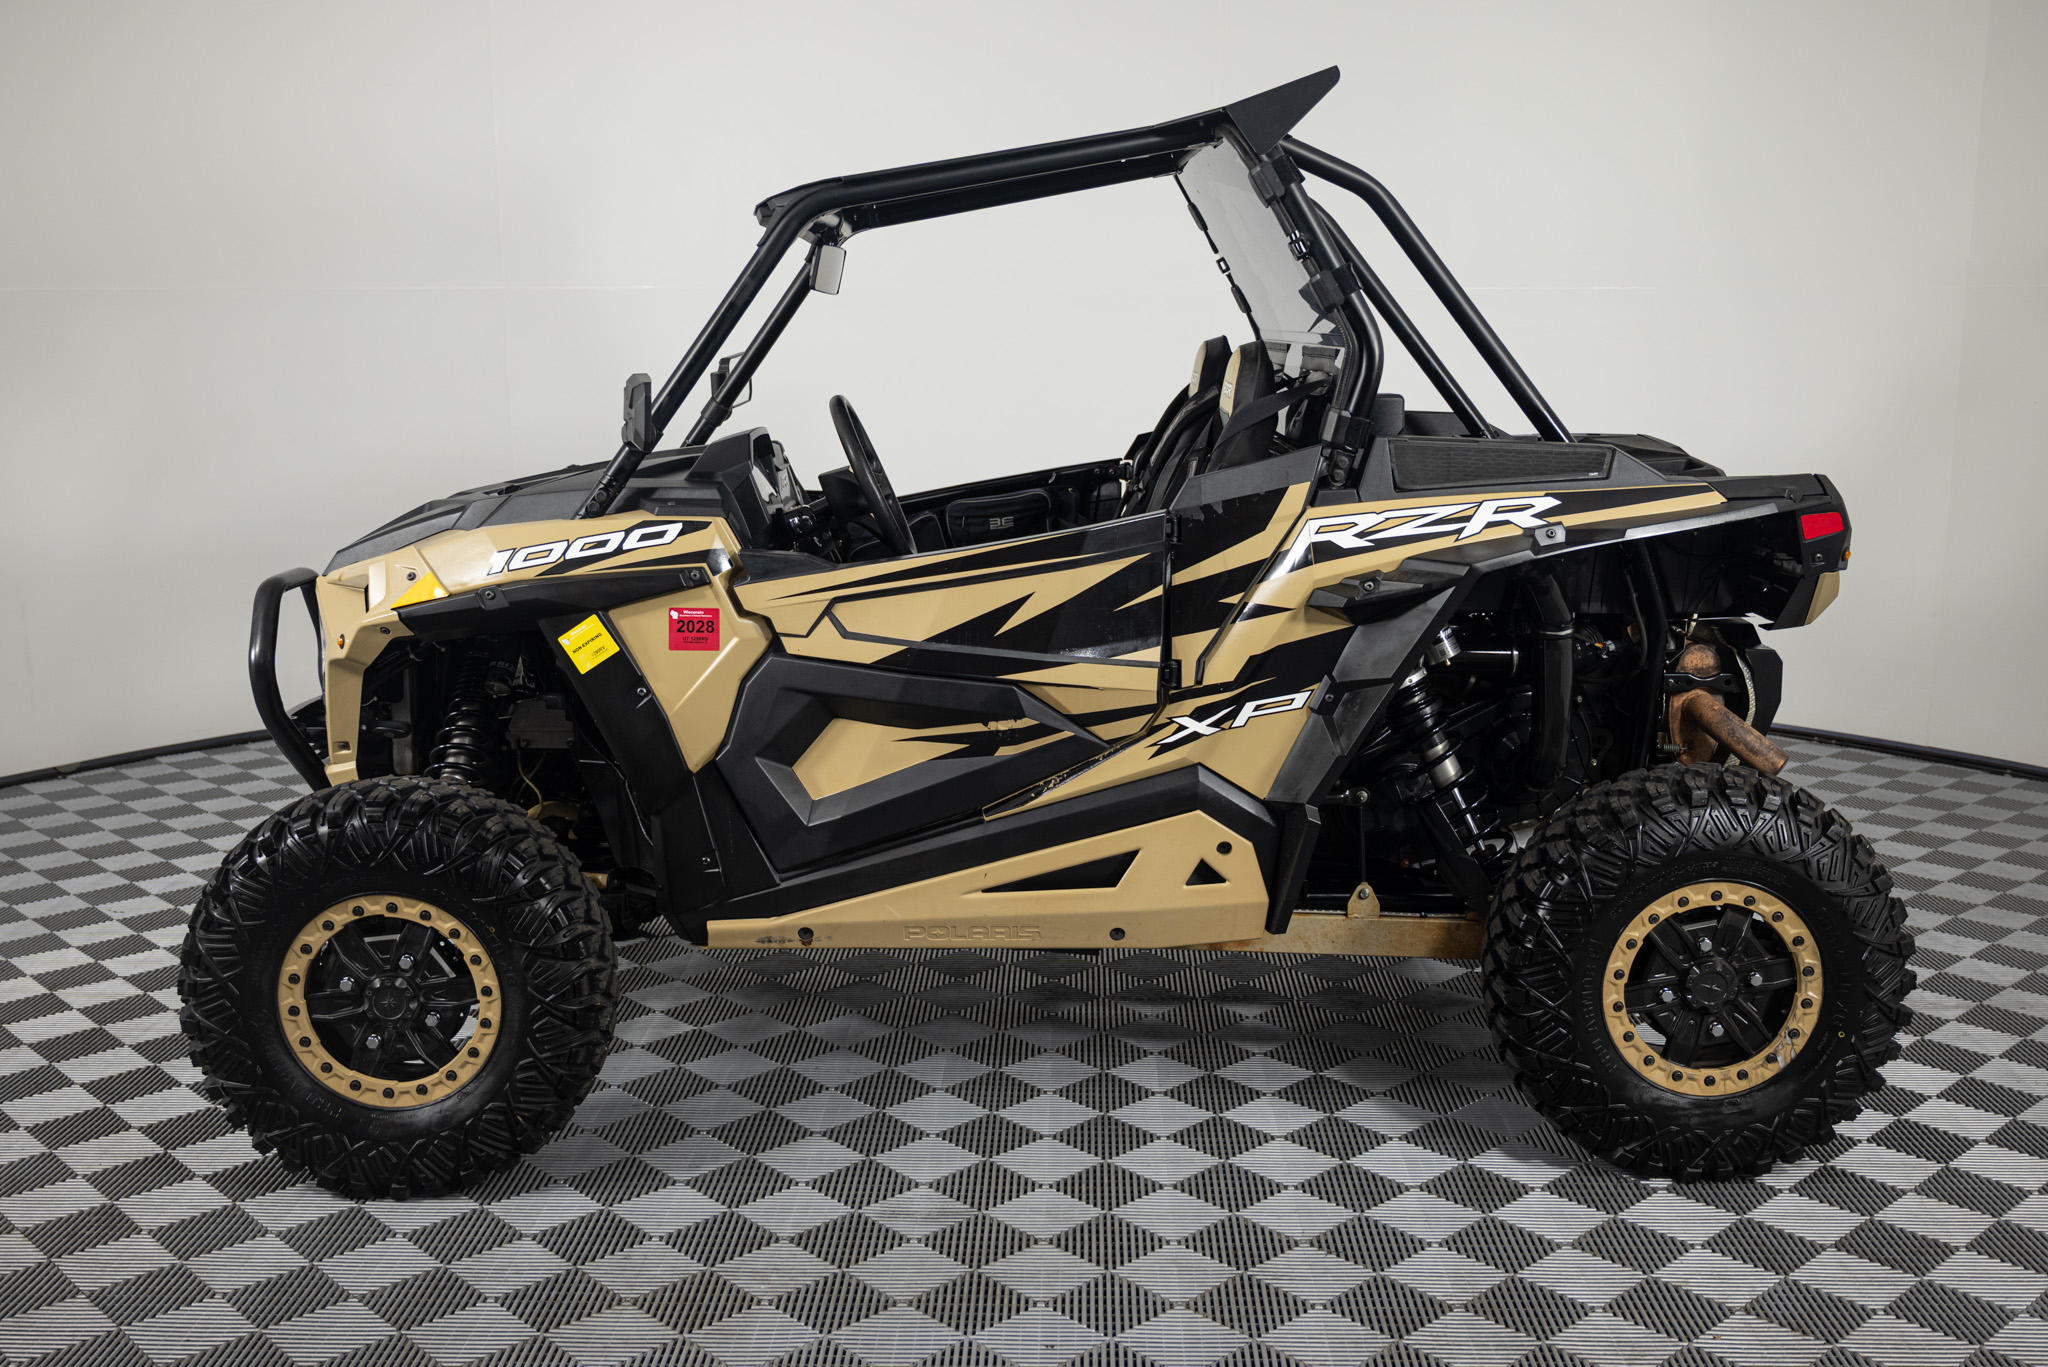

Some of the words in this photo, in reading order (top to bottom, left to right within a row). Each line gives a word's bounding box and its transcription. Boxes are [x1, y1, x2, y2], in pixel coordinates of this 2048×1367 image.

[487, 522, 683, 576] 1000
[1287, 496, 1563, 557] RZR
[676, 619, 715, 634] 2028
[1157, 689, 1313, 746] XP
[903, 925, 1042, 941] POLARIS
